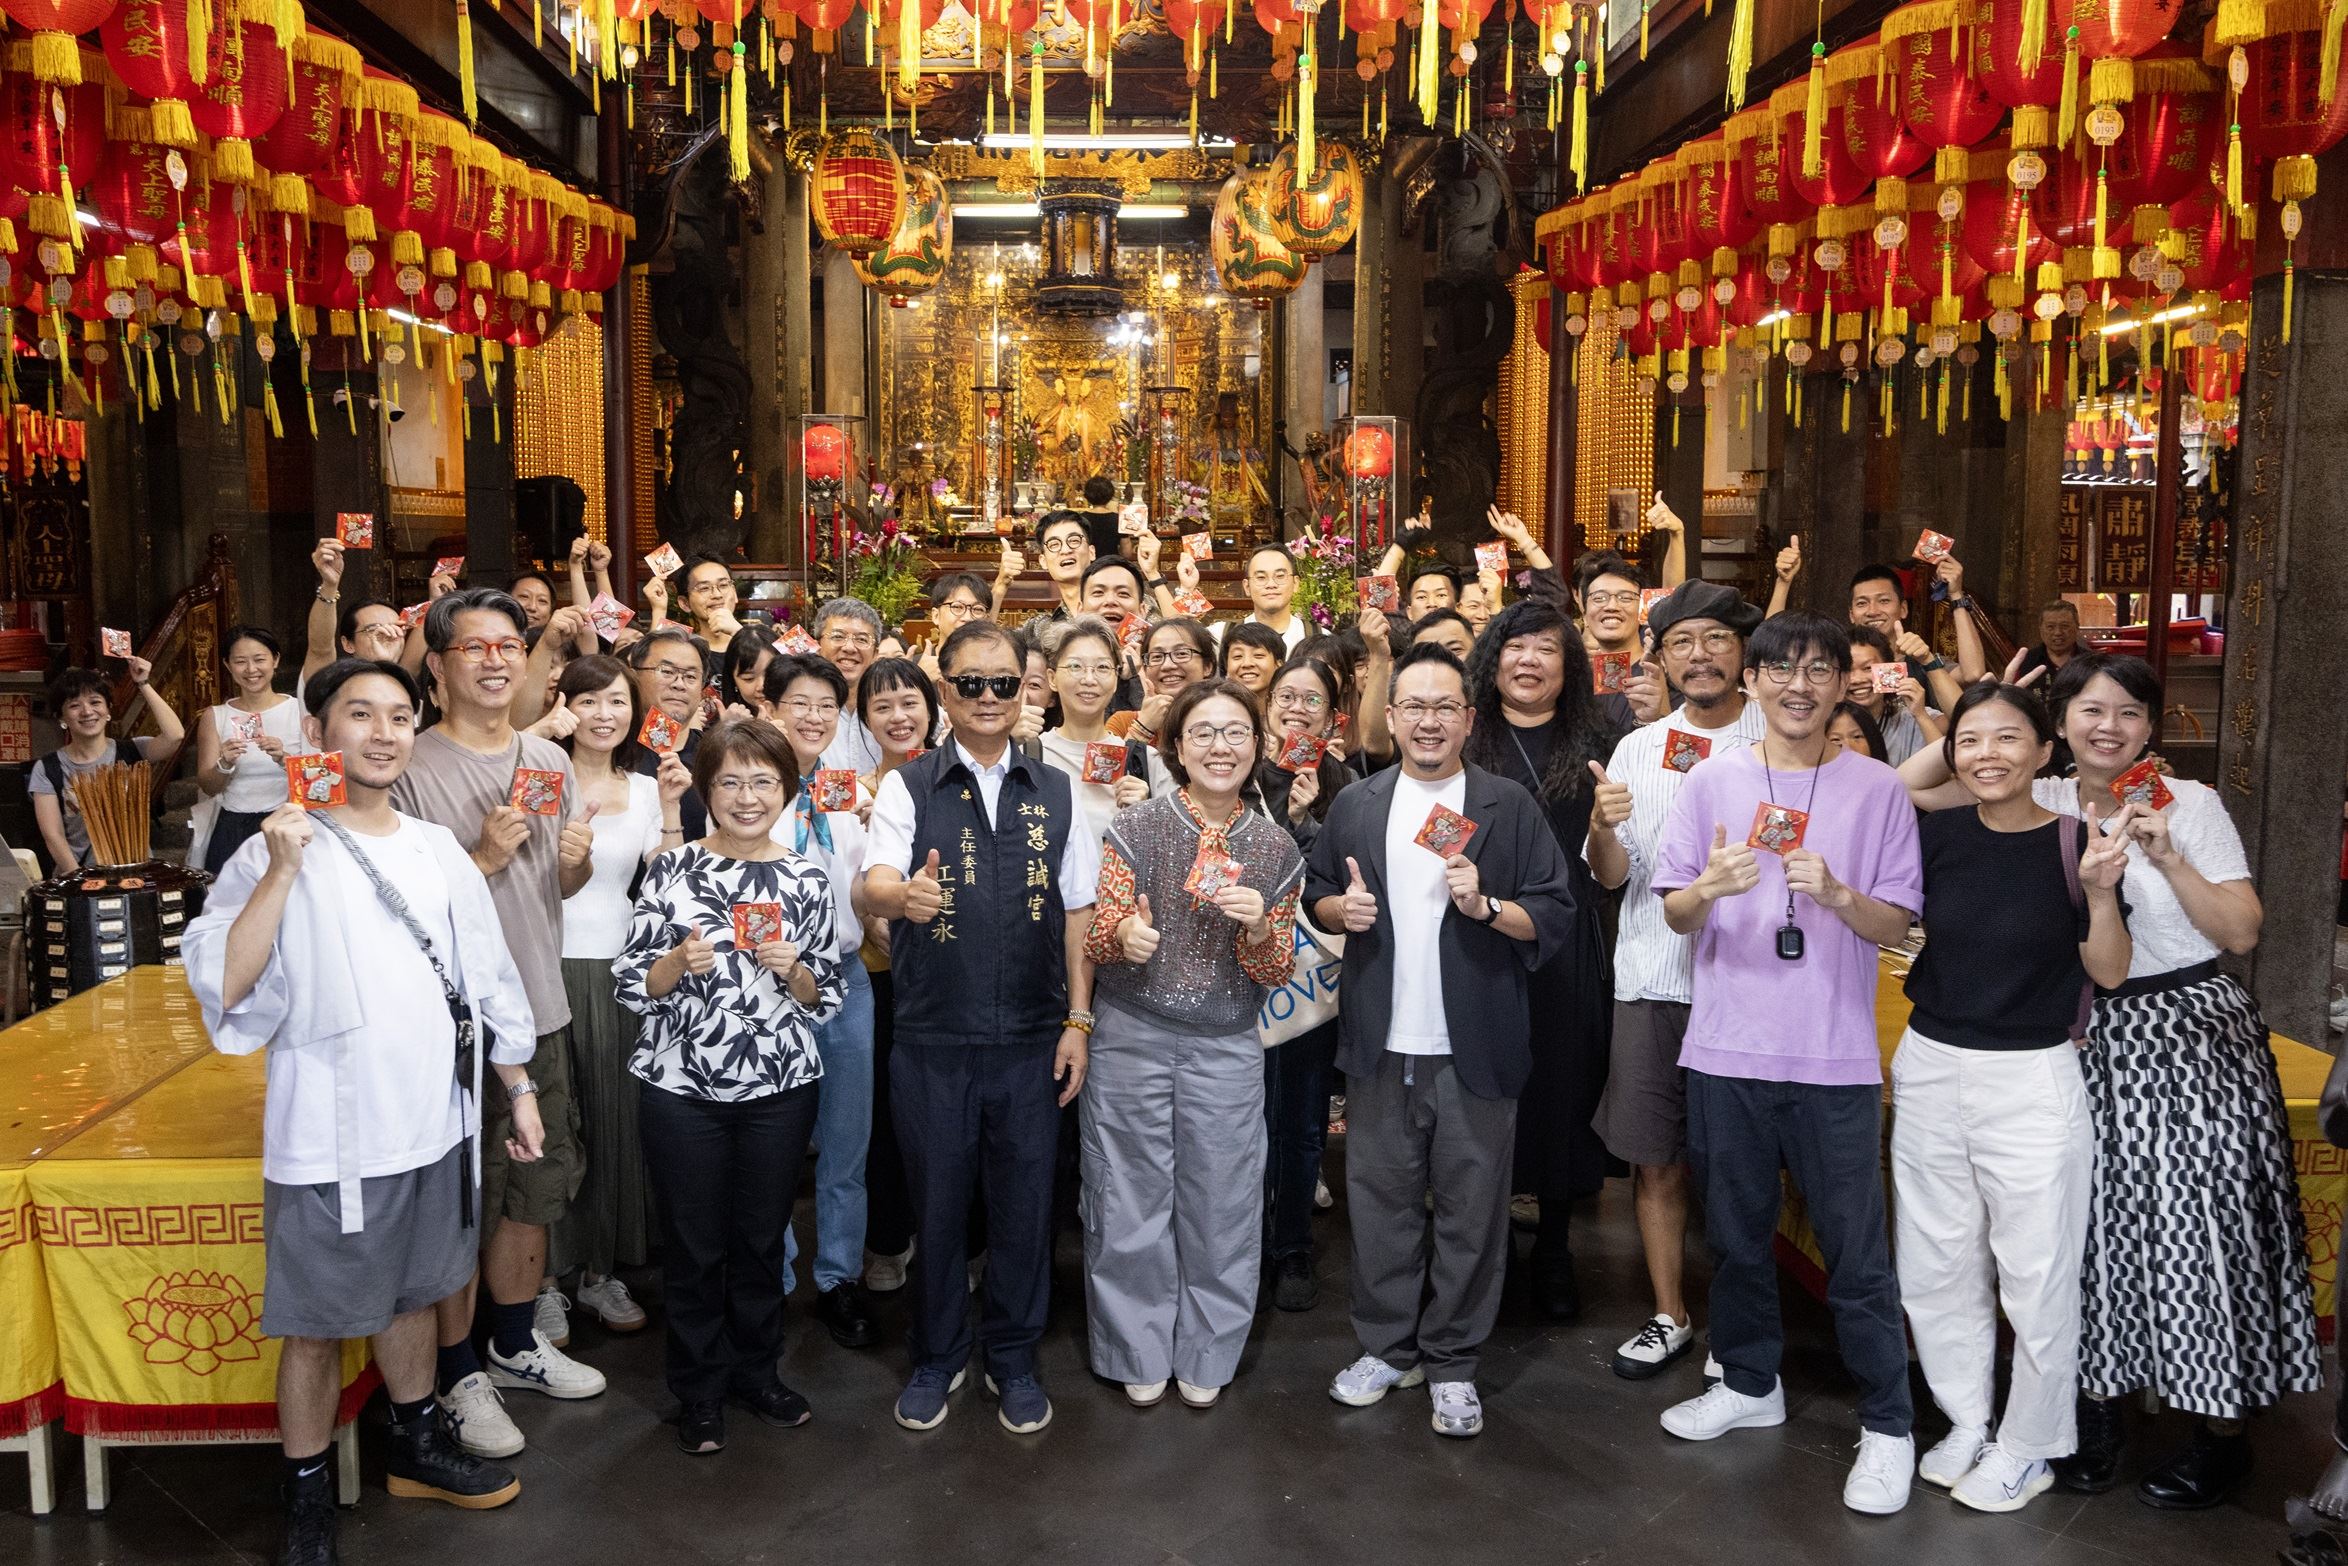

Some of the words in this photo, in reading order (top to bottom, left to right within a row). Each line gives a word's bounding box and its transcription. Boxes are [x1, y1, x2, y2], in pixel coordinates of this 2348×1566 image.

[1910, 33, 1937, 123] 國泰民安
[2095, 126, 2115, 135] 0193
[1697, 161, 1719, 229] 國泰民安
[2016, 171, 2037, 180] 0195
[2105, 495, 2147, 583] 肅靜
[1017, 802, 1050, 819] 士林
[960, 827, 978, 886] 主任委員
